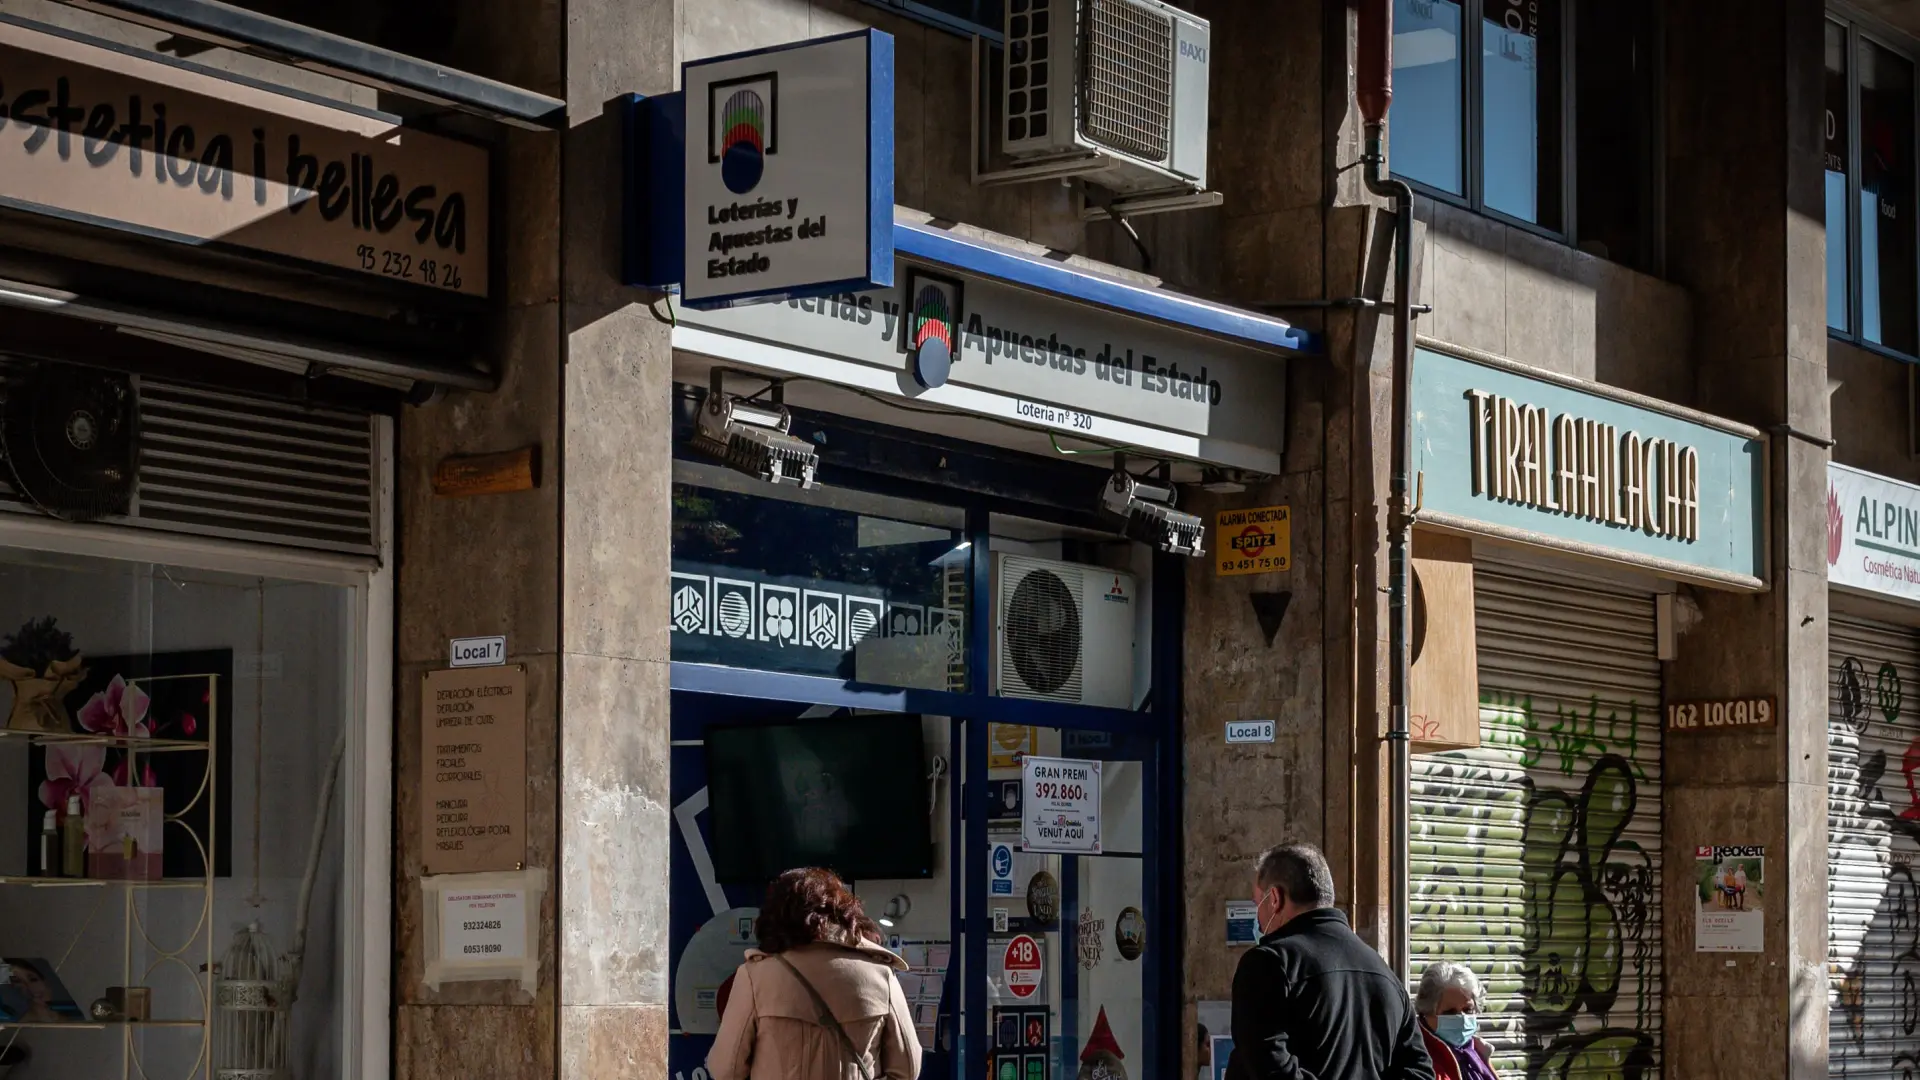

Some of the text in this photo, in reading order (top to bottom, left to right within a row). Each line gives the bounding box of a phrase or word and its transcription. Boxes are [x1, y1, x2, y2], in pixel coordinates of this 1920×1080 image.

[1180, 40, 1206, 64] BAXI
[253, 127, 267, 206] i
[287, 134, 465, 255] bellesa
[708, 196, 798, 225] Loterías y
[708, 215, 826, 256] Apuestas del
[357, 244, 462, 289] 93 232 48 26
[707, 252, 770, 279] Estado
[881, 300, 899, 341] y
[964, 312, 1086, 375] Apuestas
[1095, 343, 1133, 386] del
[1141, 355, 1221, 406] Estado
[1016, 399, 1054, 422] Lotería
[1073, 413, 1092, 430] 320
[1220, 509, 1287, 526] ALARMA CONECTADA
[1856, 495, 1918, 547] ALPIN
[1235, 534, 1272, 548] SPITZ
[1222, 557, 1286, 570] 93 451 75 00
[1864, 555, 1903, 580] Cosmética
[455, 643, 502, 660] Local 7
[1668, 703, 1698, 728] 162
[1229, 725, 1271, 738] Local 8
[1034, 766, 1087, 780] GRAN PREMI
[1035, 782, 1082, 800] 392.860
[1038, 825, 1084, 839] VENUT AQUÍ
[463, 920, 501, 930] 932324826
[1078, 919, 1104, 935] ORTEJO
[463, 944, 502, 954] 605318090
[1012, 942, 1033, 962] +18
